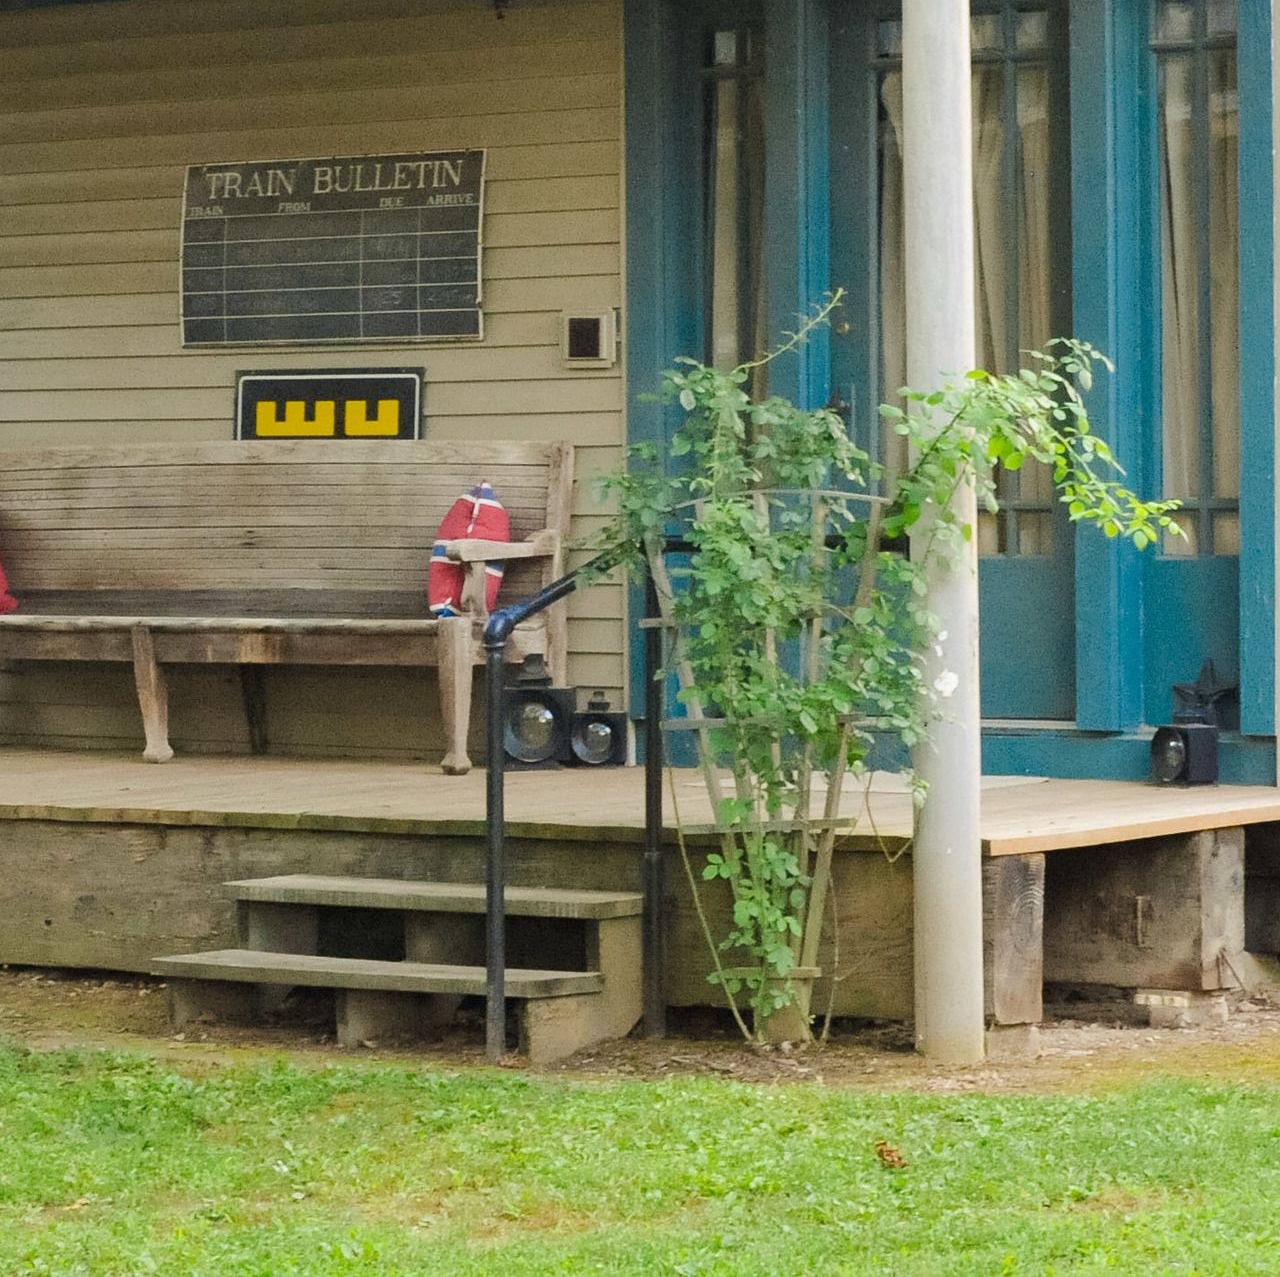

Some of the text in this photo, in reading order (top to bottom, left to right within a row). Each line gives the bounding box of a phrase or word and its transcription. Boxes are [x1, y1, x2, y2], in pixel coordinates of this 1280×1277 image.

[205, 159, 464, 200] TRAIN BULLETIN
[379, 196, 404, 208] DUE
[426, 193, 475, 205] ARRIVE
